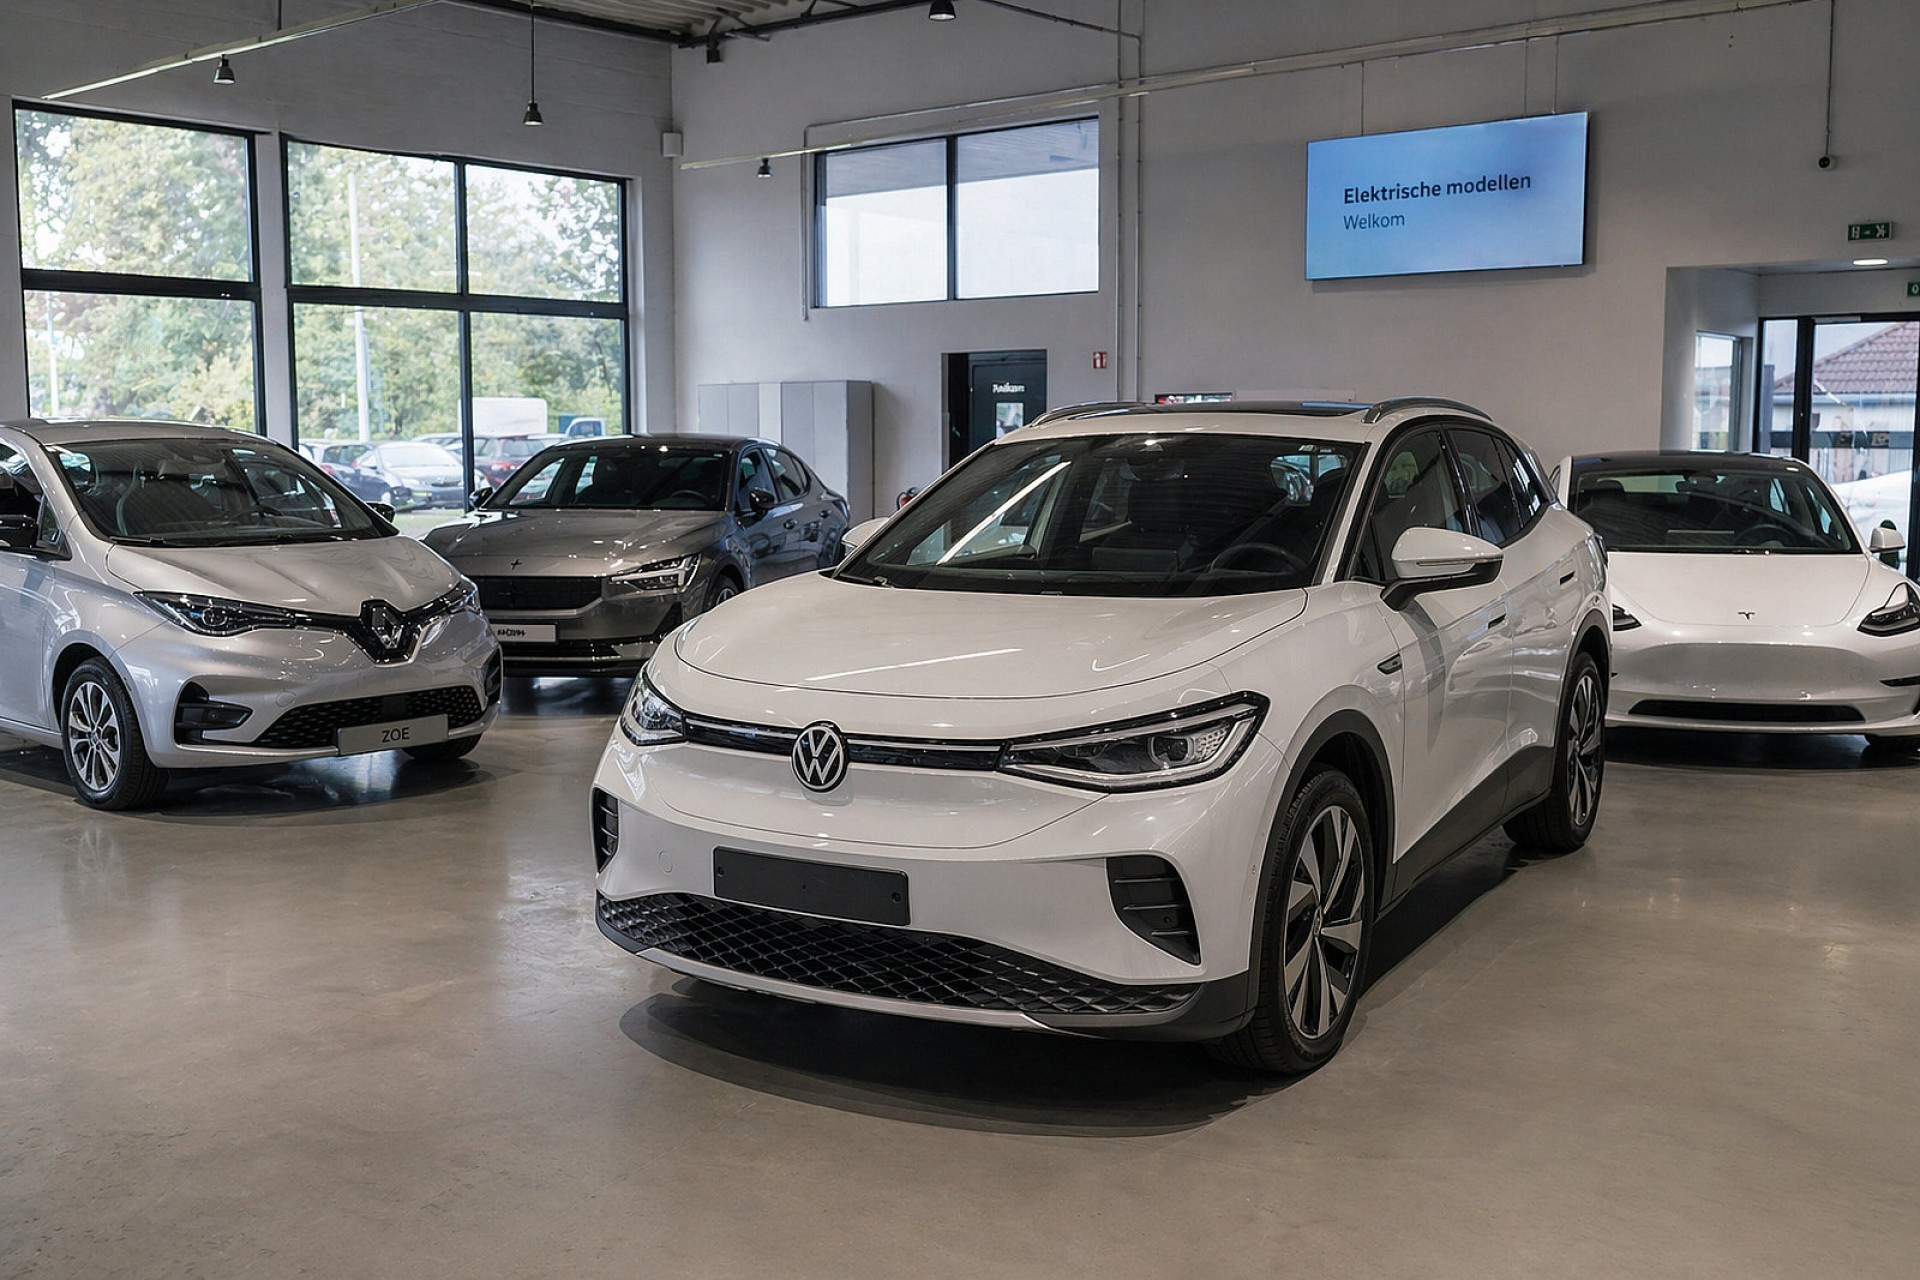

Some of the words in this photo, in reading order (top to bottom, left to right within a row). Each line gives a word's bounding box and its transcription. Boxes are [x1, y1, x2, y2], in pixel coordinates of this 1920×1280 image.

[1343, 181, 1441, 204] Elektrische
[1446, 174, 1531, 196] modellen
[1343, 213, 1405, 230] Welkom
[381, 727, 410, 743] ZOE
